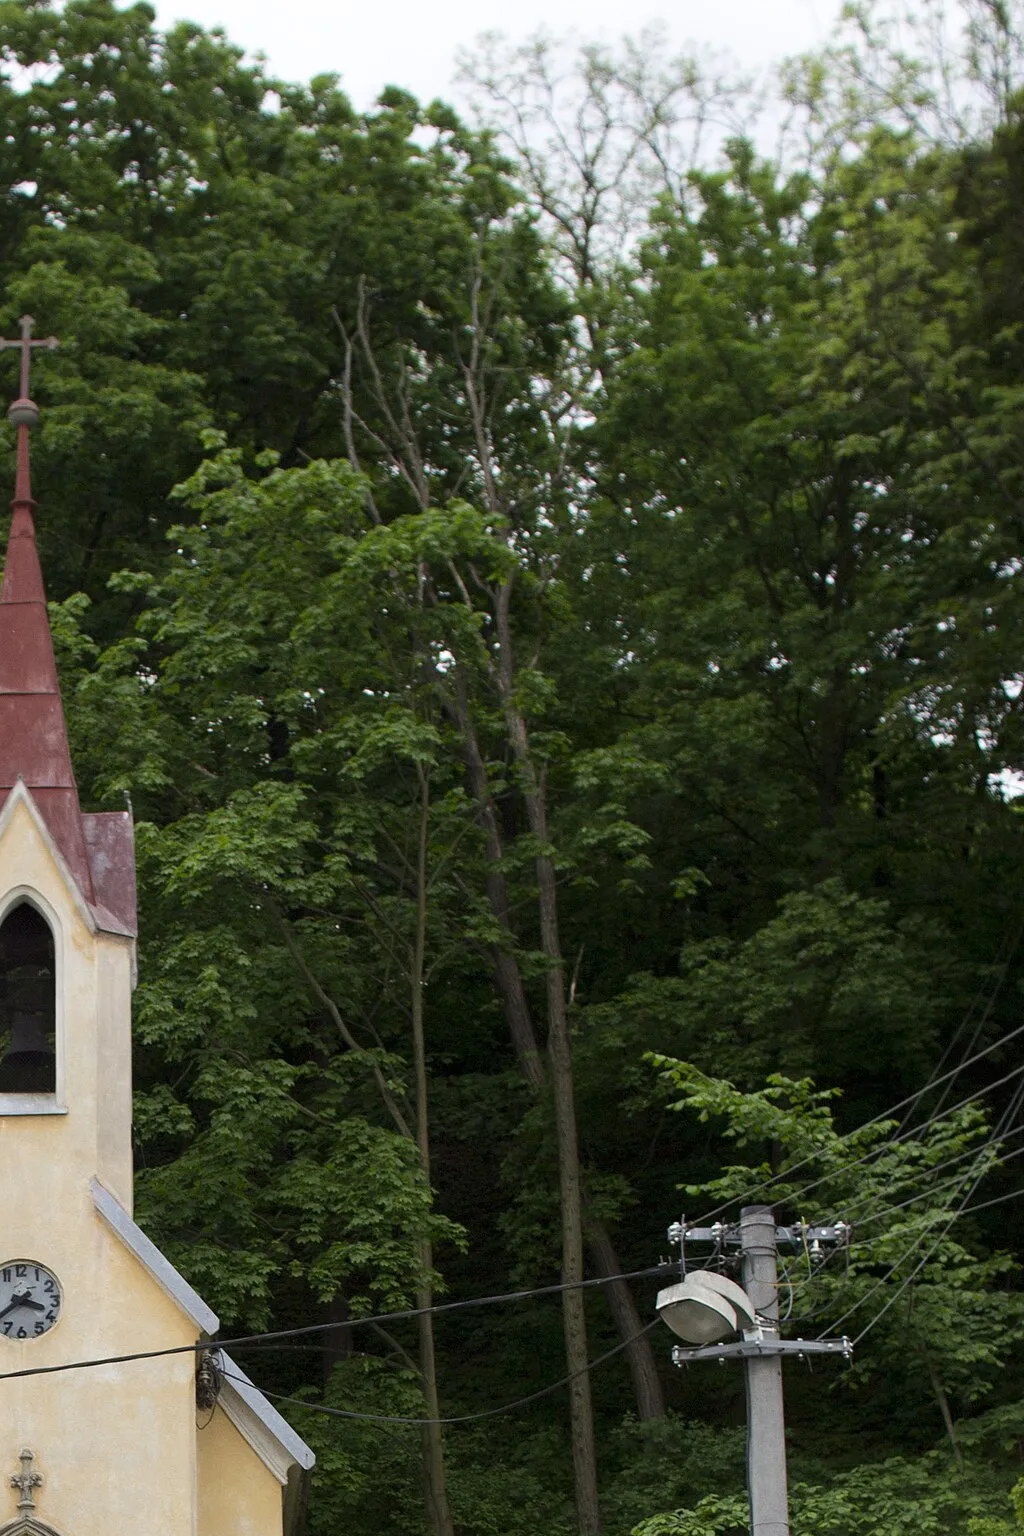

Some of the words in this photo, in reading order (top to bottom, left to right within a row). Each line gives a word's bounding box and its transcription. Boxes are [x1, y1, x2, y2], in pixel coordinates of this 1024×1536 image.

[3, 1269, 11, 1282] 11
[15, 1264, 27, 1277] 12
[34, 1269, 39, 1281] 1
[44, 1280, 54, 1292] 2
[50, 1295, 60, 1307] 3
[45, 1310, 56, 1323] 4
[3, 1321, 13, 1335] 7
[17, 1326, 27, 1338] 6
[34, 1322, 44, 1335] 5
